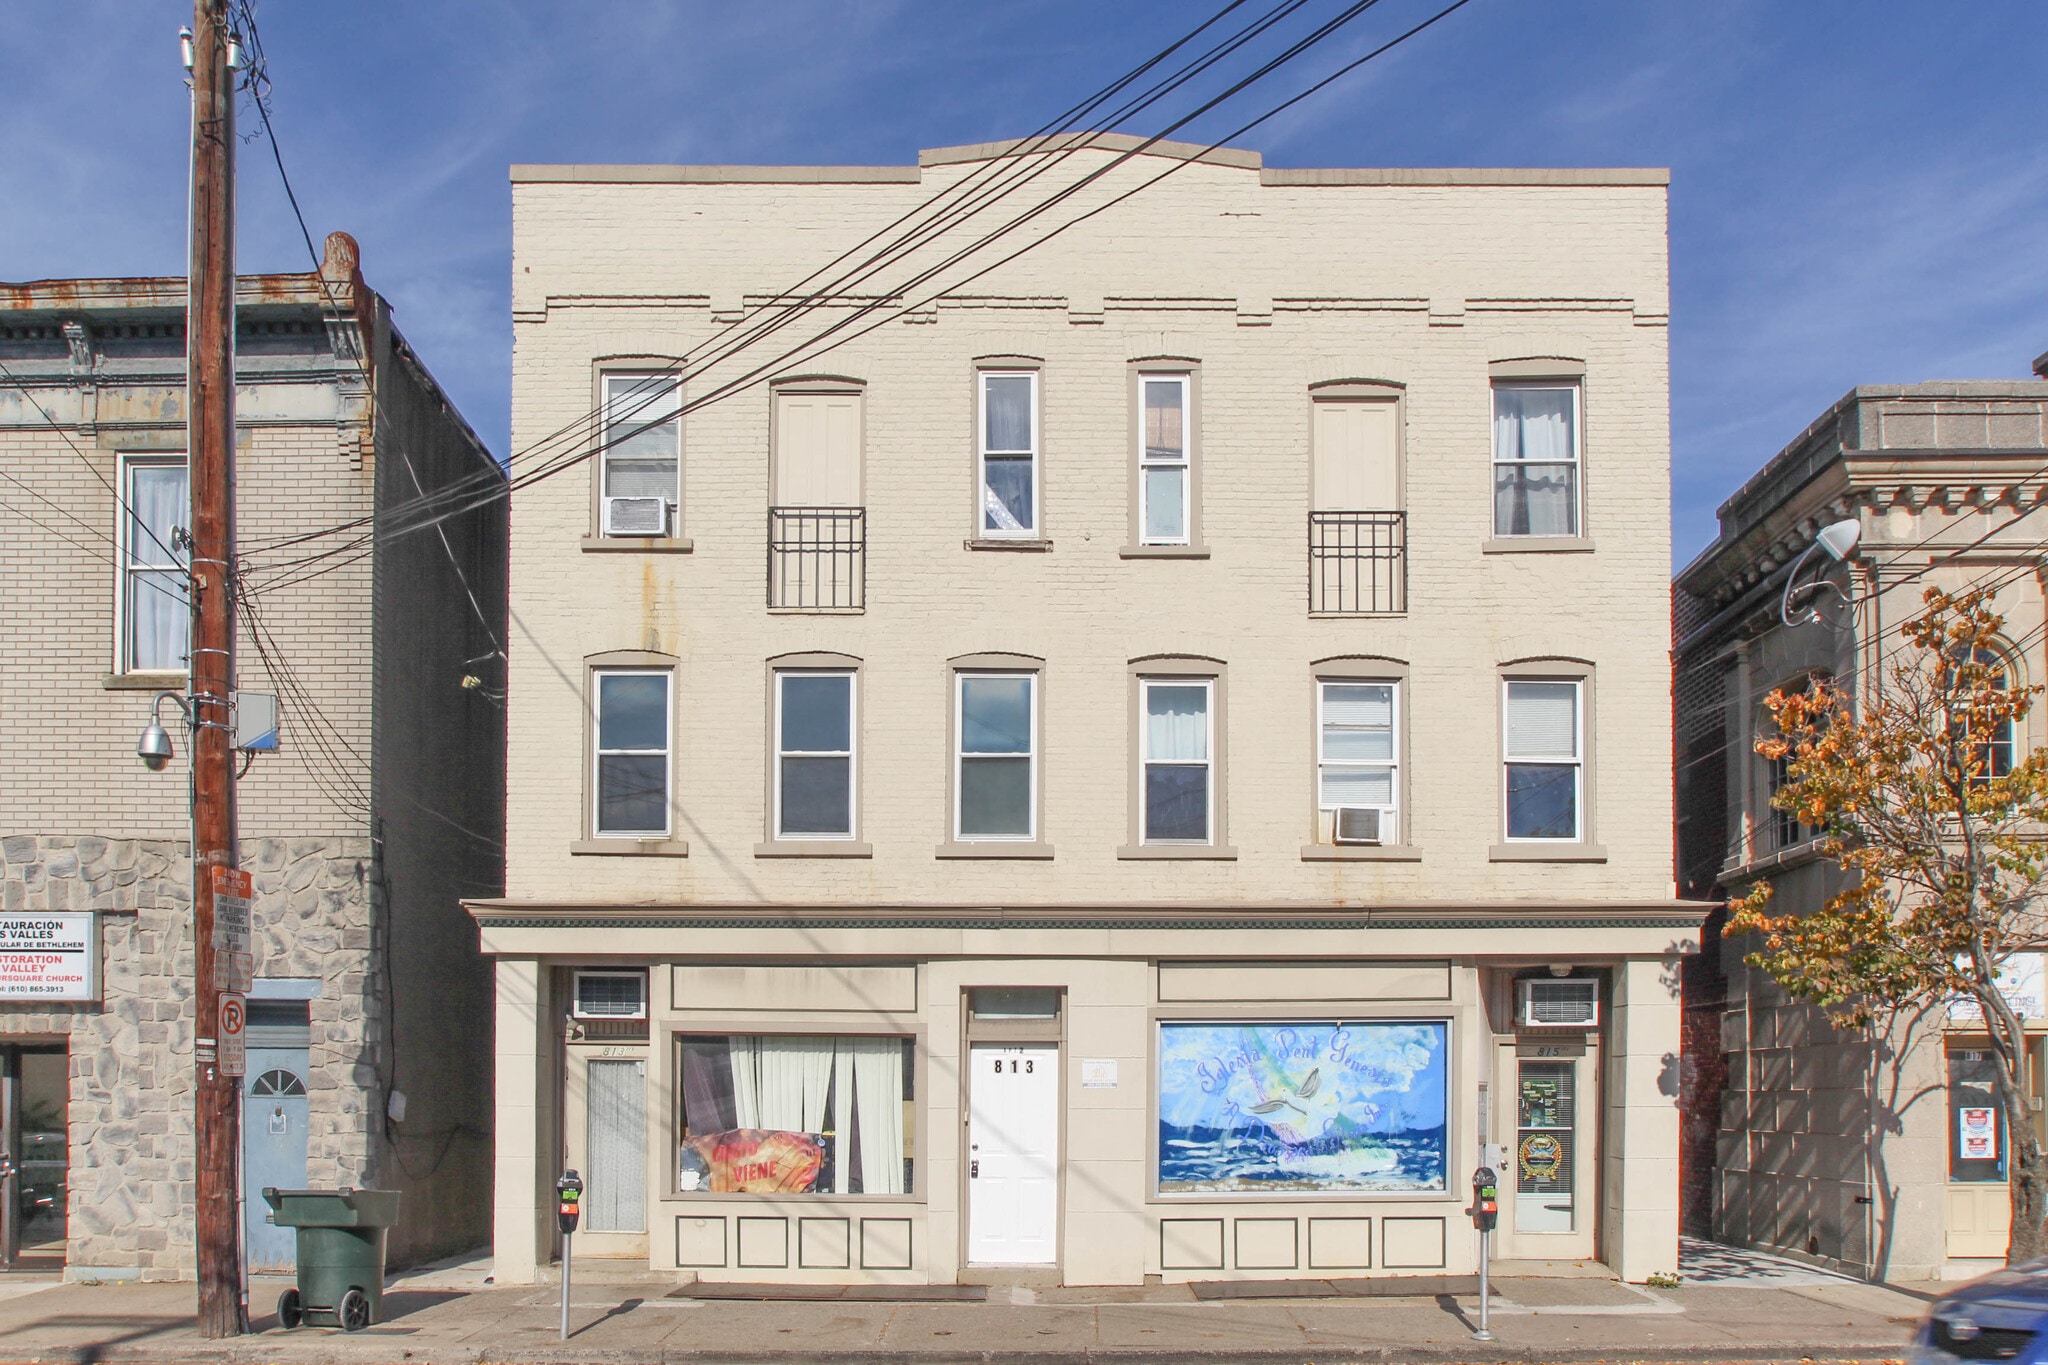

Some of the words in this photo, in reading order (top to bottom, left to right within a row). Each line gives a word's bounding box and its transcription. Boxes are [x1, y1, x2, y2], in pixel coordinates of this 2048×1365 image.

[0, 920, 63, 929] AURACIÓN
[10, 930, 54, 939] VALLES
[2, 964, 46, 973] VALLEY
[1537, 1047, 1560, 1057] 815
[994, 1060, 1034, 1073] 813
[733, 1160, 777, 1183] VIENE
